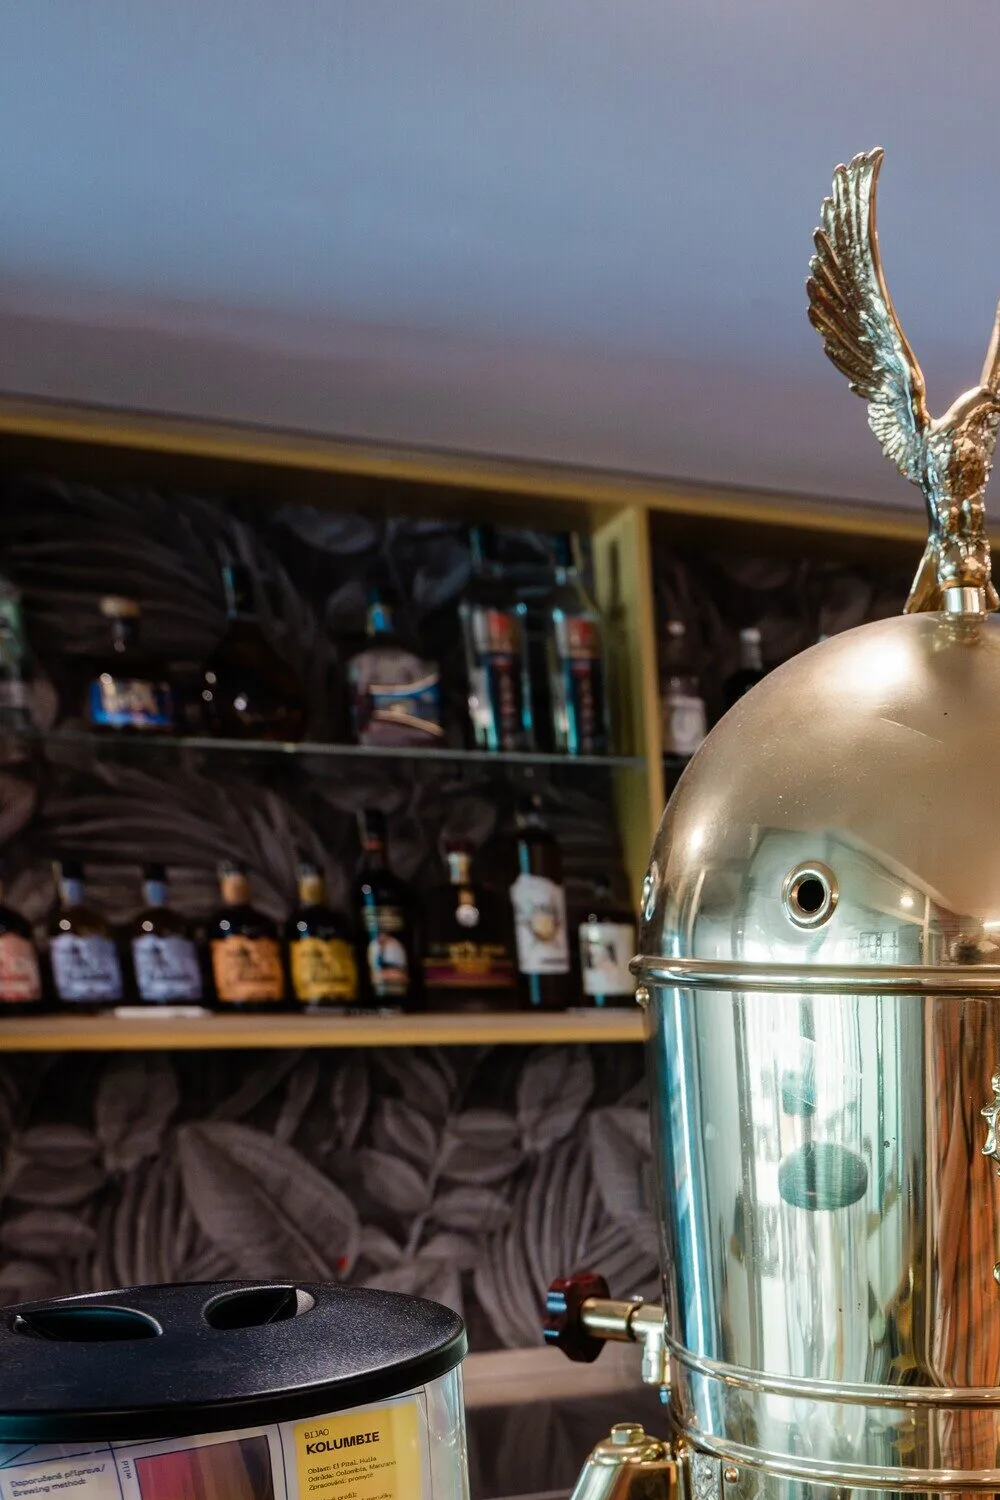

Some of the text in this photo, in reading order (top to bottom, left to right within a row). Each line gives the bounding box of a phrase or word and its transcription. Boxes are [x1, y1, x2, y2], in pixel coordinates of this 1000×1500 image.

[304, 1428, 330, 1440] BIJAO
[306, 1431, 380, 1455] KOLUMBIE
[121, 1460, 132, 1479] wild
[12, 1485, 51, 1497] Brewing
